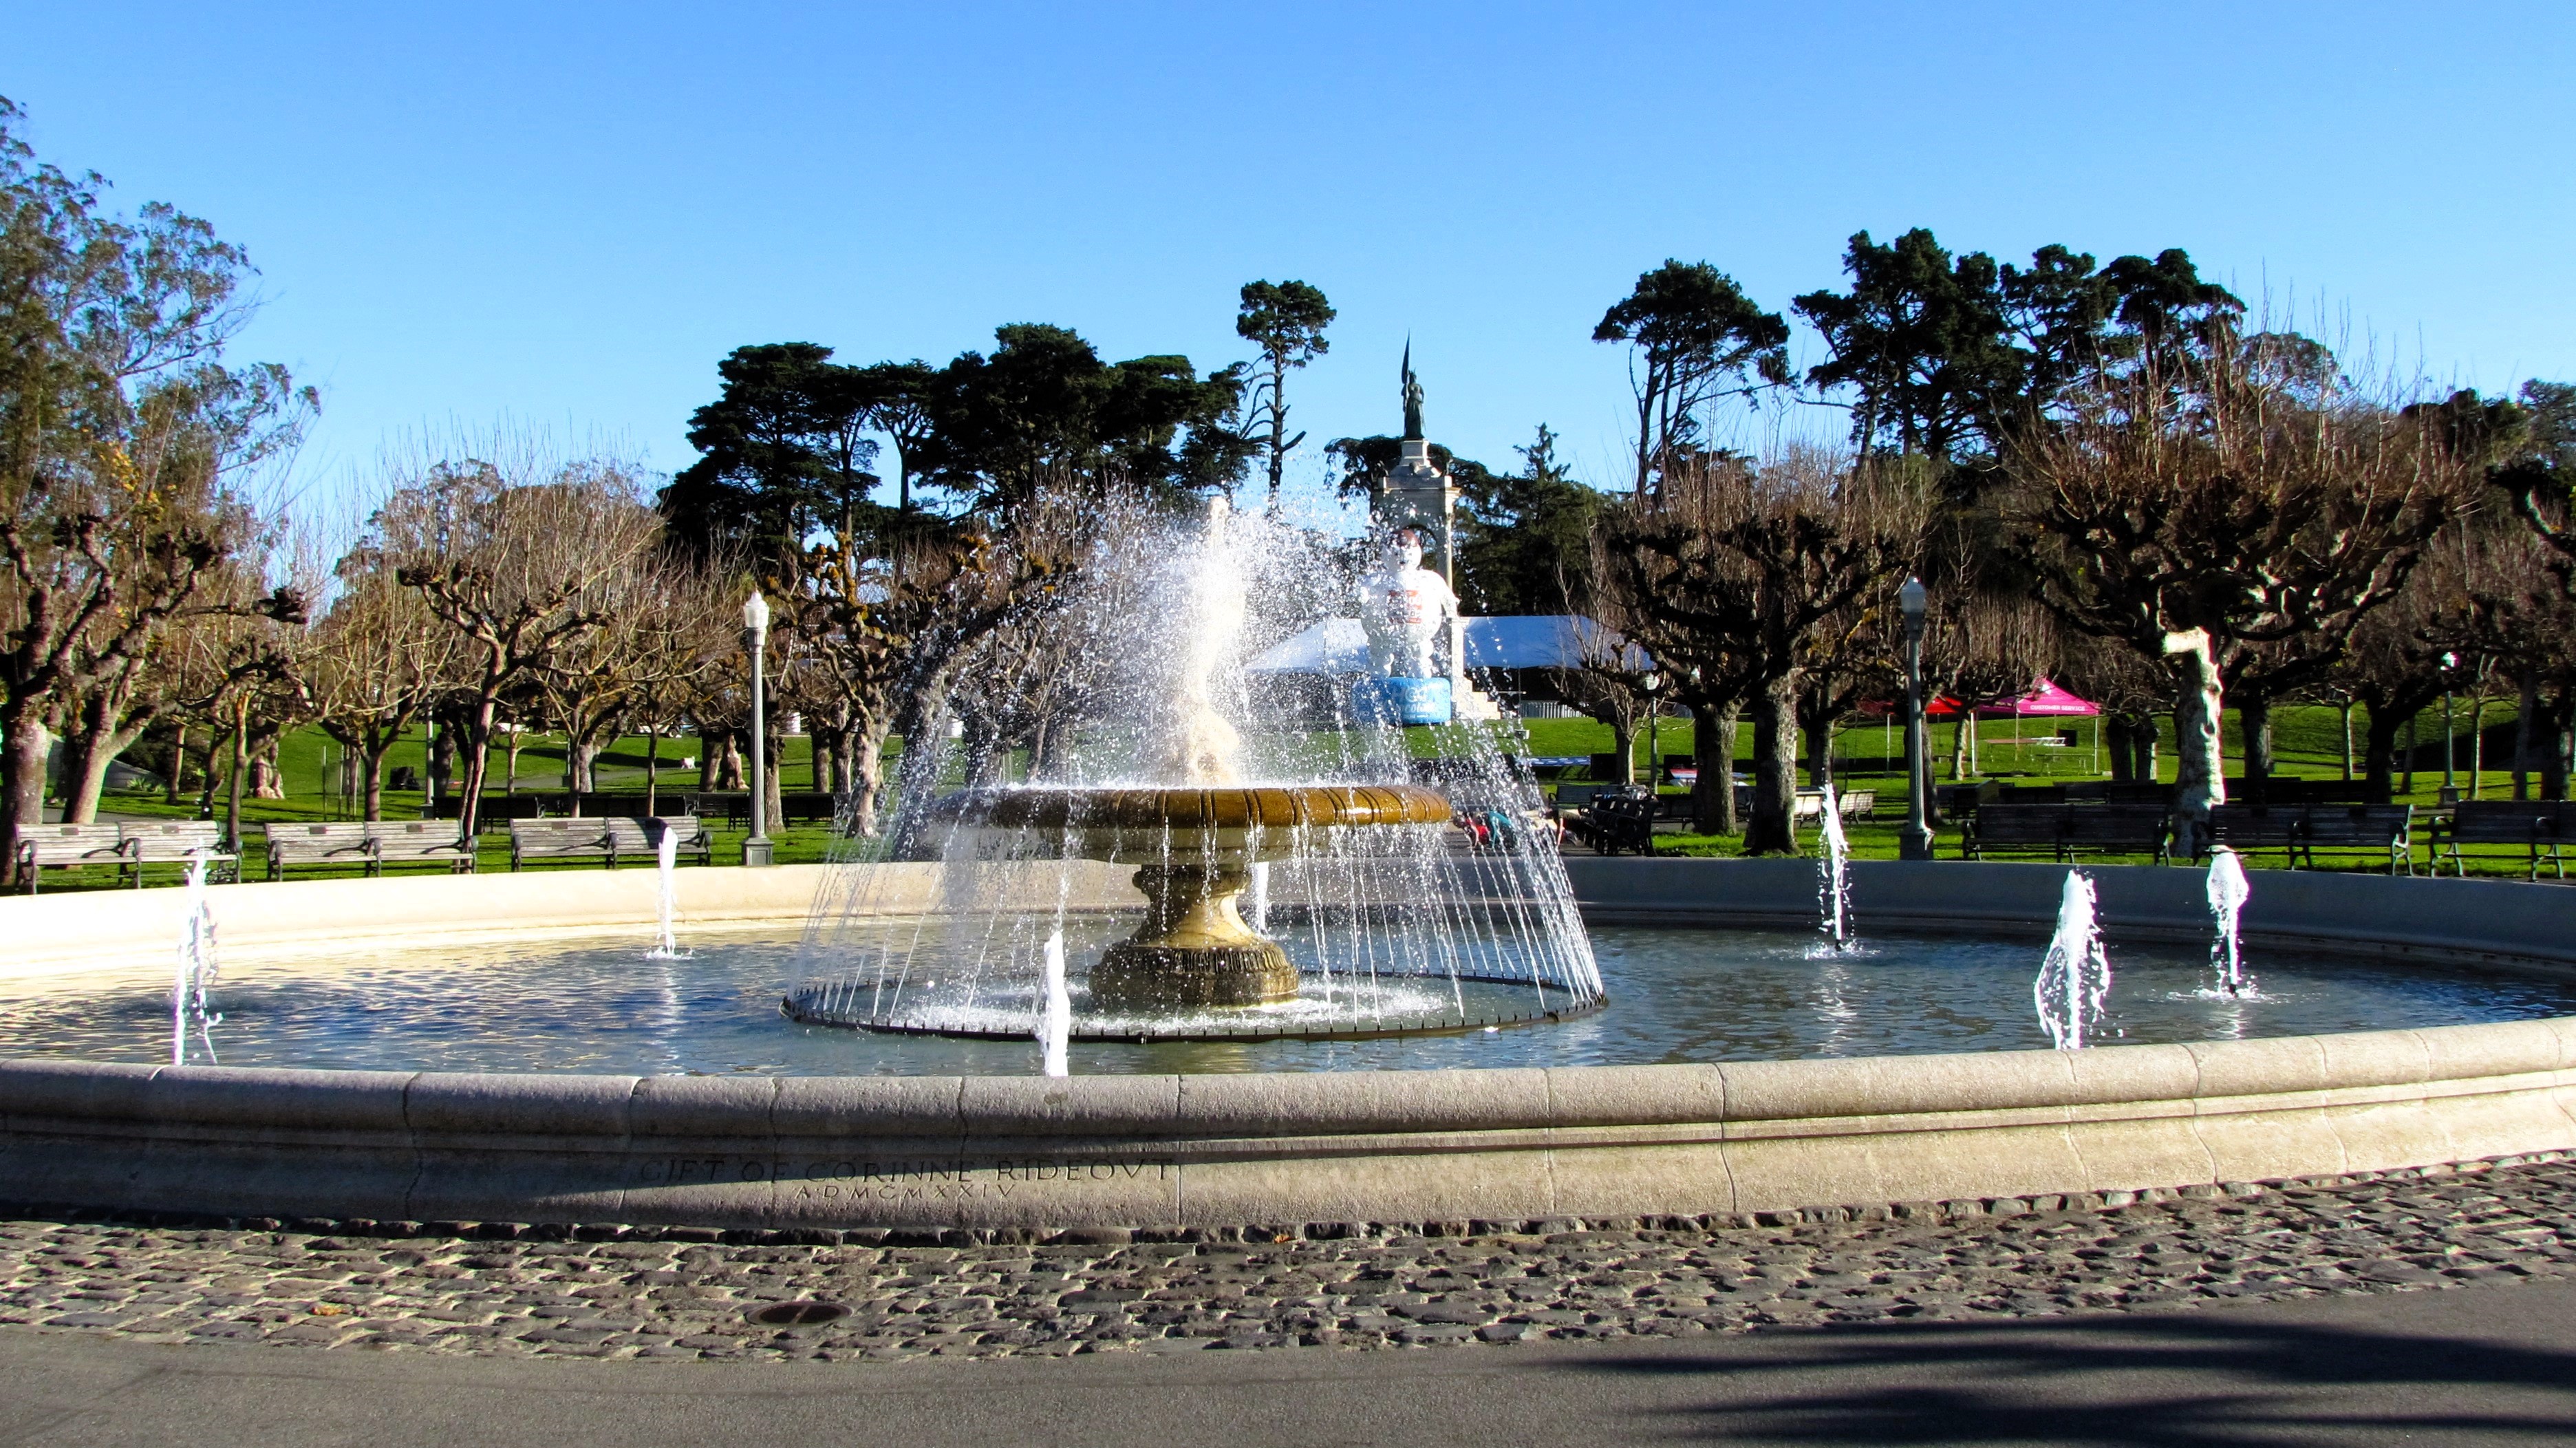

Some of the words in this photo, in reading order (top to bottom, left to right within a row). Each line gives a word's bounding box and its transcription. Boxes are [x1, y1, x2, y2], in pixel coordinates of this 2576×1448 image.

[639, 1160, 724, 1182] GIFT
[740, 1160, 791, 1182] OF
[806, 1159, 974, 1182] CORINNE
